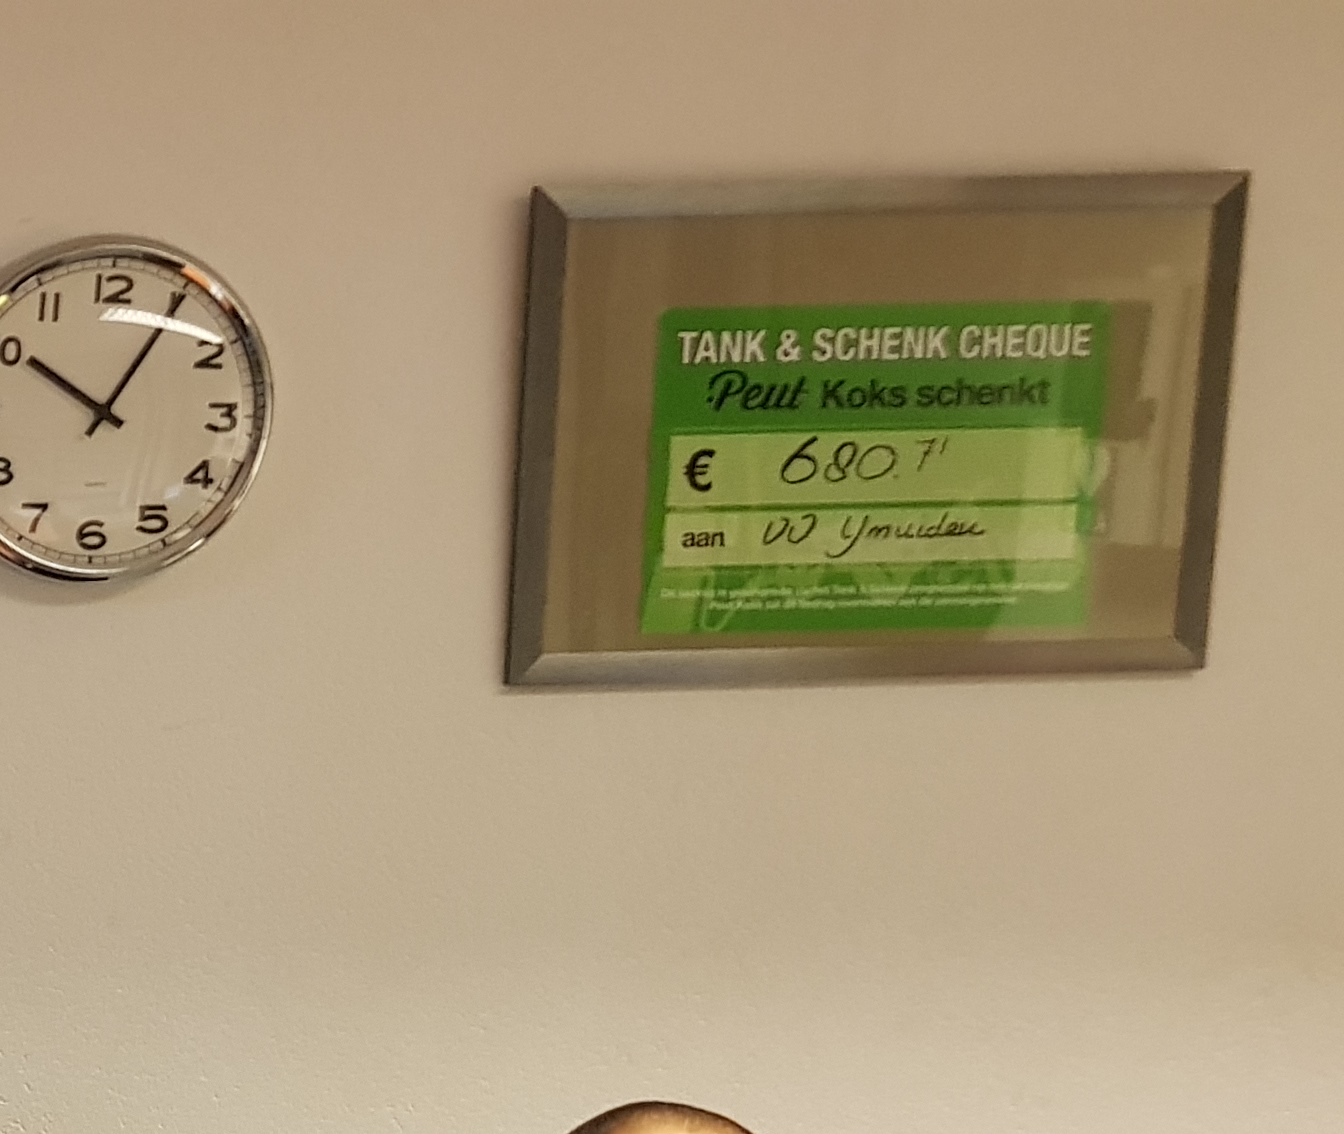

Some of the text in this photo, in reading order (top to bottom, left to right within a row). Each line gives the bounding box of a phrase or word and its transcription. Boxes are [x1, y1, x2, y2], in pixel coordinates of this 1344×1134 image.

[93, 274, 134, 304] 12
[38, 292, 60, 322] 11
[192, 339, 225, 370] 2
[678, 323, 1093, 364] TANK & SCHENK CHEQUE
[707, 369, 1051, 411] Peut Koks schenkt
[204, 402, 238, 432] 3
[183, 459, 214, 489] 4
[683, 449, 716, 491] €
[21, 502, 49, 533] 7
[136, 505, 169, 534] 5
[76, 520, 107, 550] 6
[681, 531, 725, 548] aan
